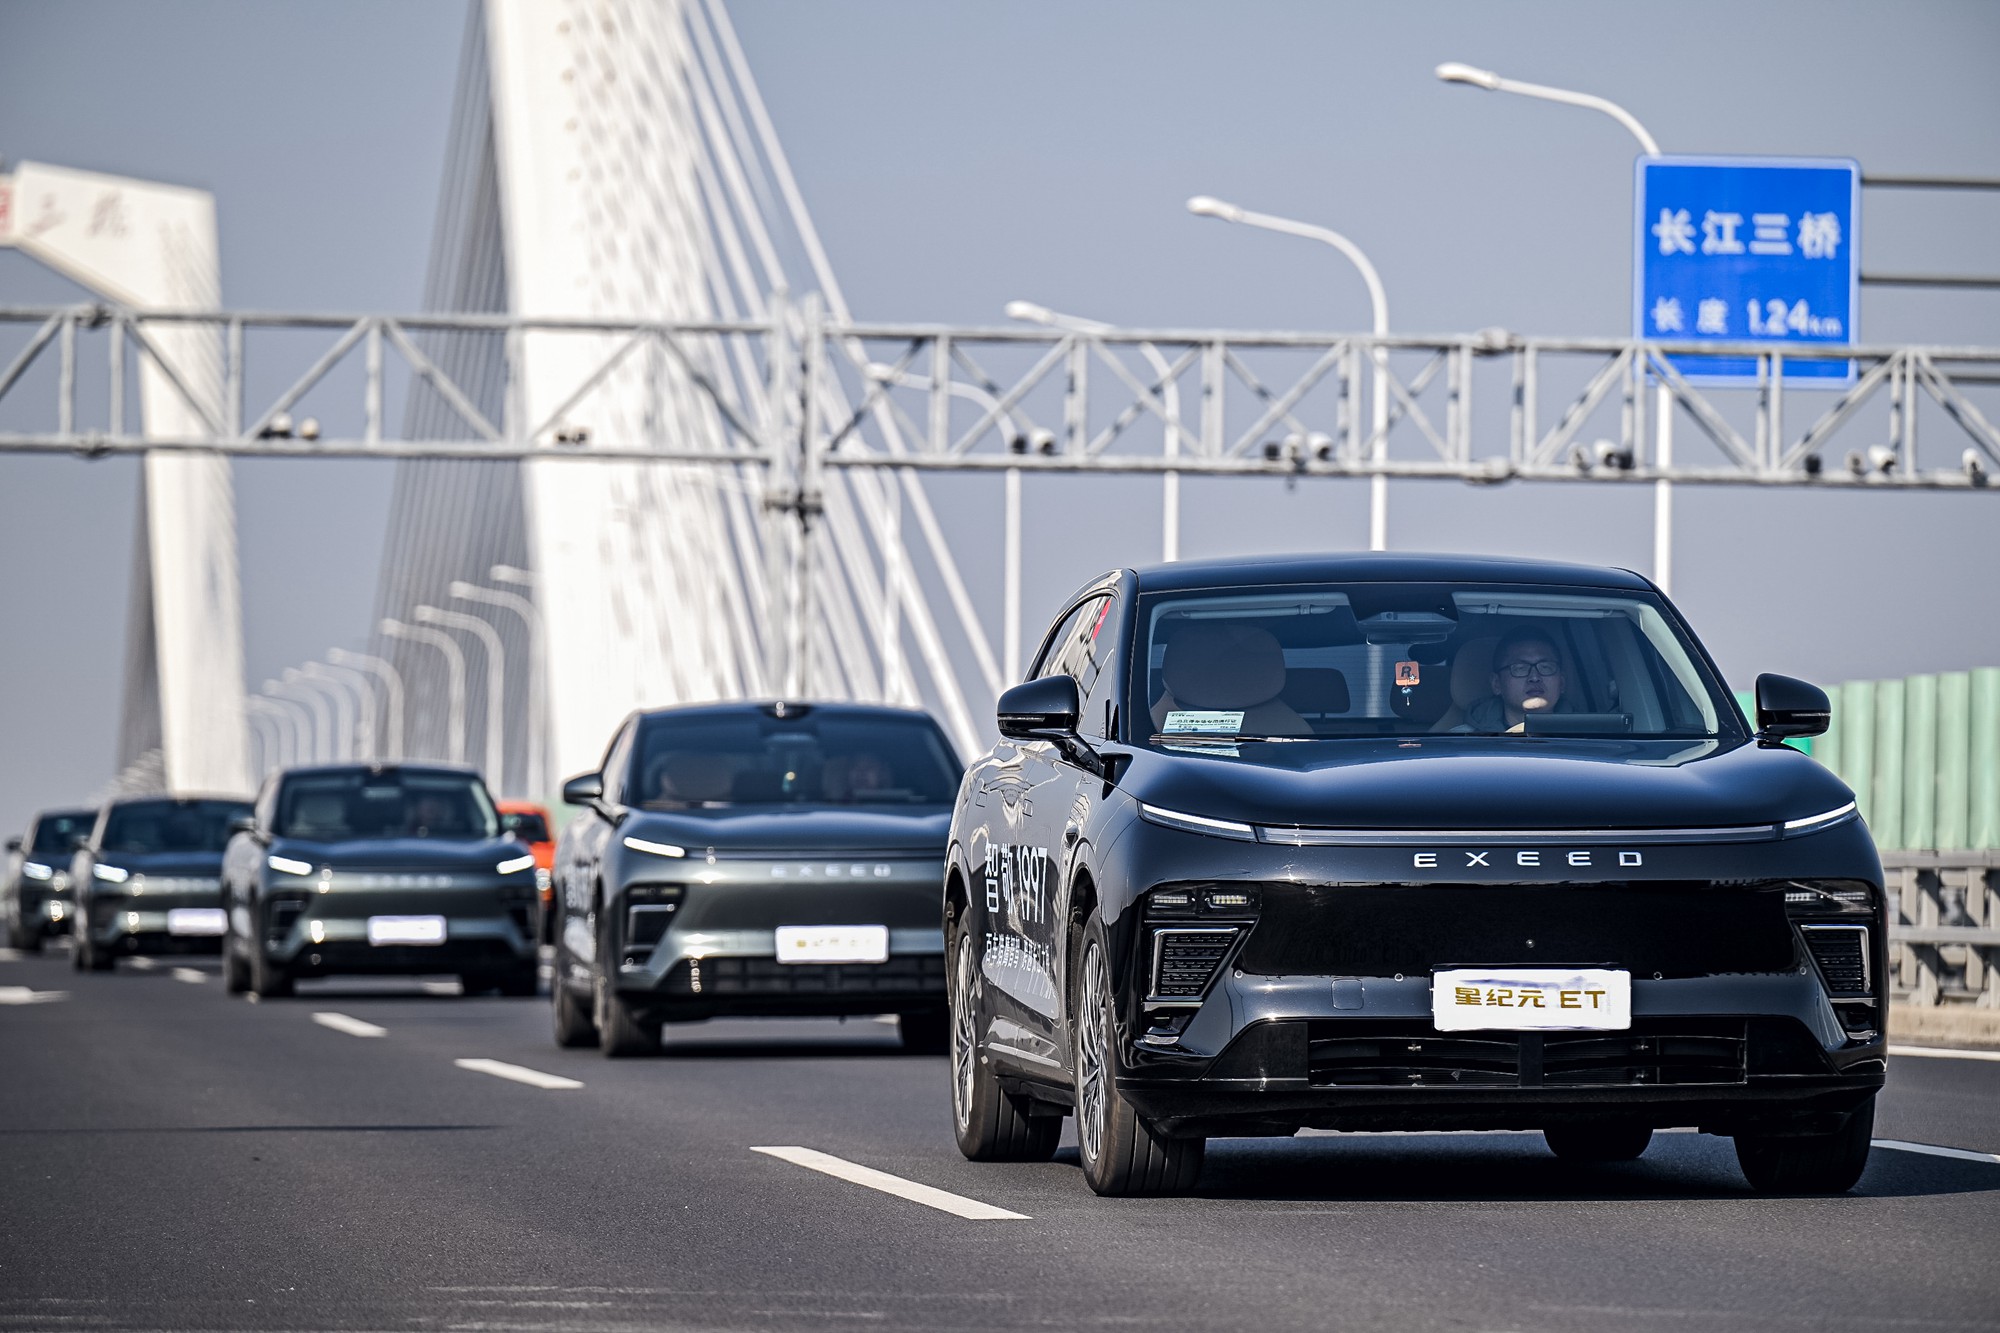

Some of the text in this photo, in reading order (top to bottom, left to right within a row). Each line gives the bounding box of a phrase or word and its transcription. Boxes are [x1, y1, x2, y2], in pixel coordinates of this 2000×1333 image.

[1652, 208, 1841, 259] 长江三桥
[1413, 851, 1643, 868] EXEED
[1455, 986, 1606, 1009] 星纪元 ET
